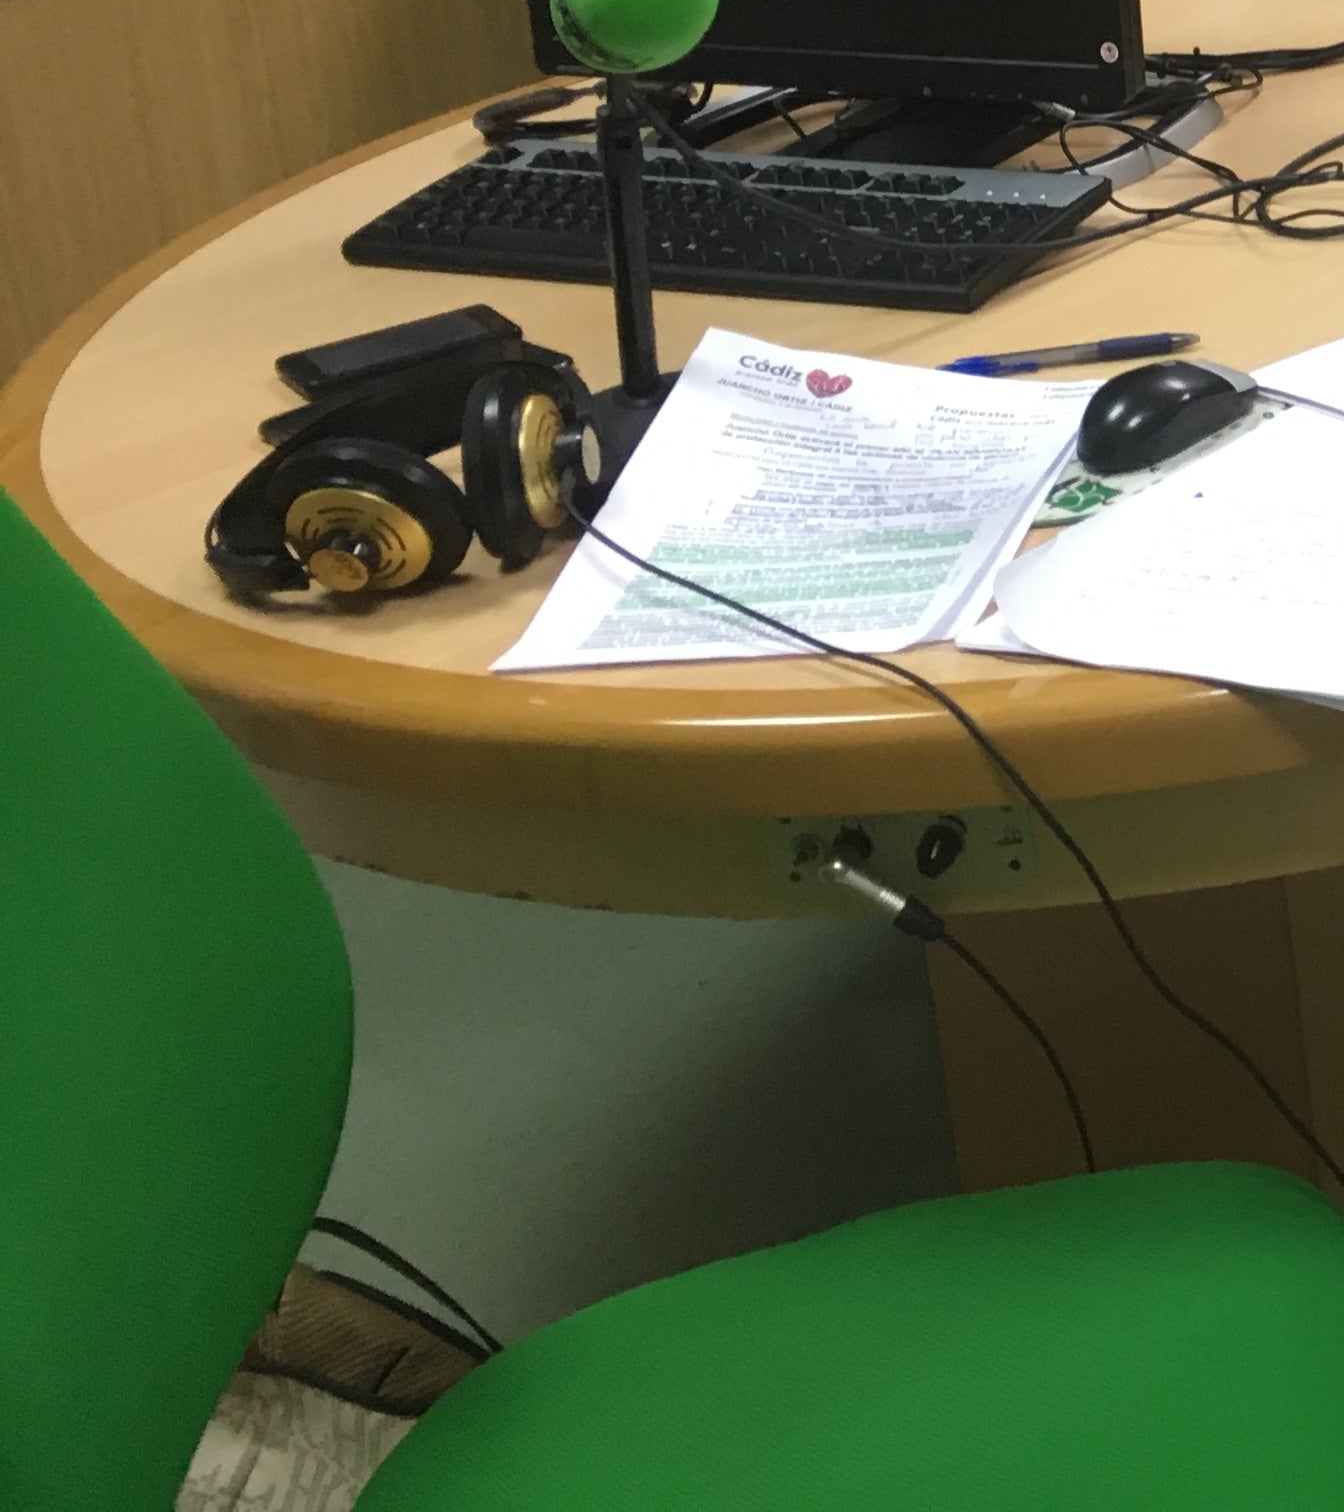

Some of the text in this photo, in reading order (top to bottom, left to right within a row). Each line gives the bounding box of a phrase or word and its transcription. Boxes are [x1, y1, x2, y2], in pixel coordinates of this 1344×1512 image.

[739, 355, 803, 383] Cádiz
[716, 378, 771, 398] JUANCHO
[935, 404, 1016, 419] Propuestas
